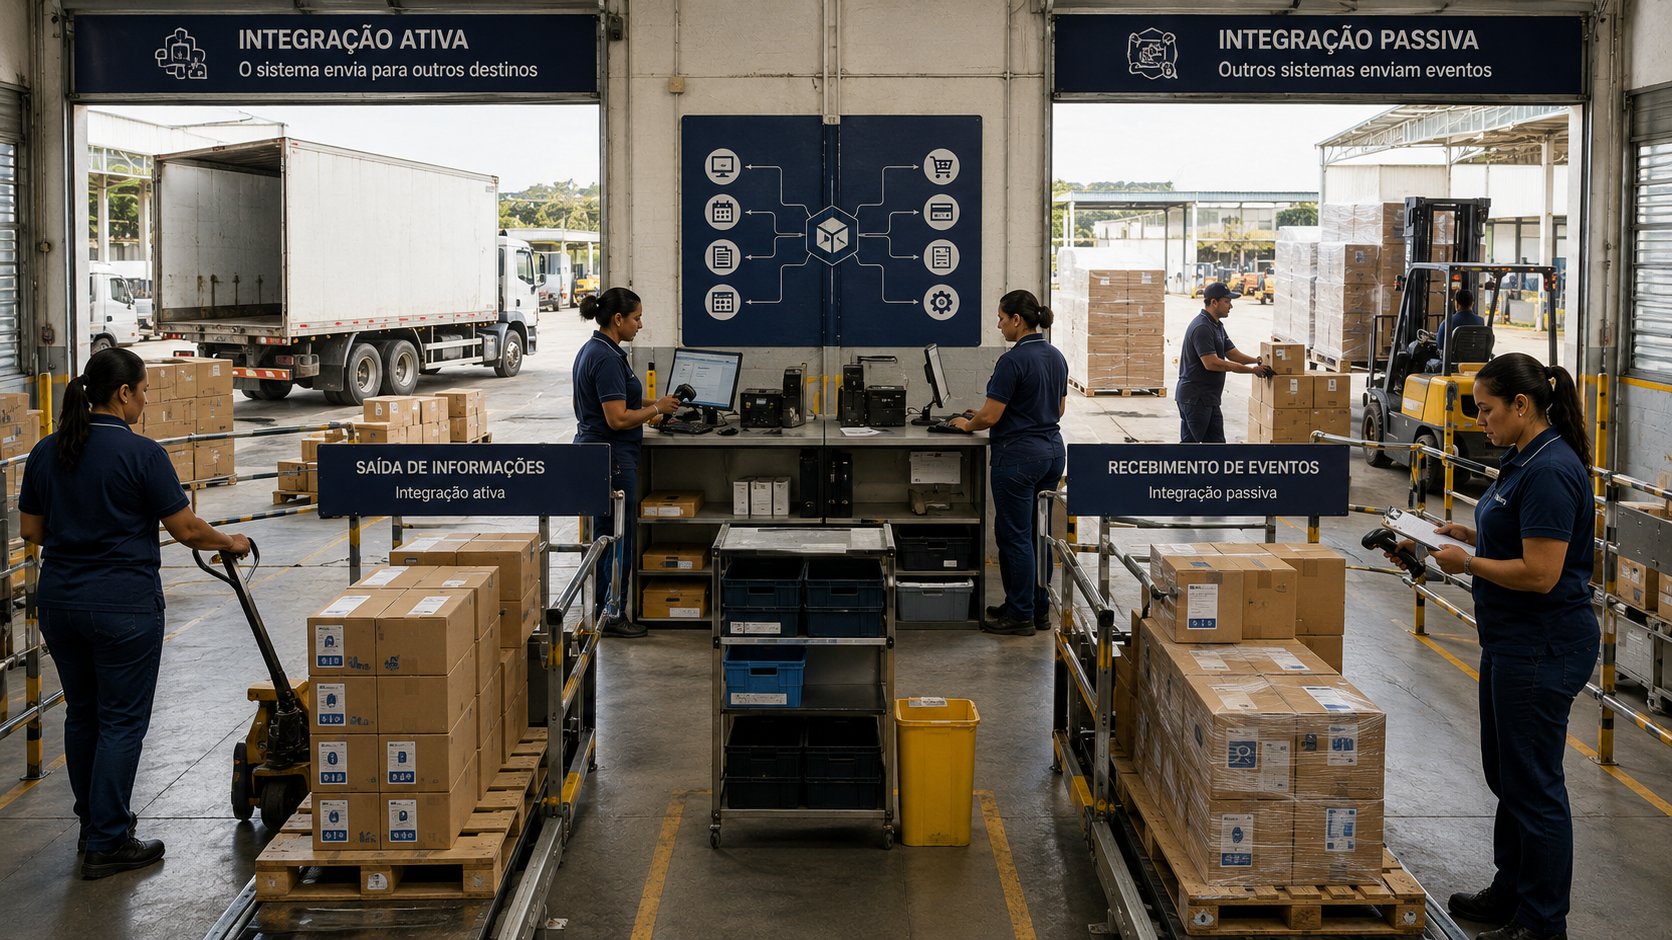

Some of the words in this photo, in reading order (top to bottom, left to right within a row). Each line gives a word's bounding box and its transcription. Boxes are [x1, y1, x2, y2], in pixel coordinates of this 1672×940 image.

[238, 24, 393, 55] INTEGRAÇÃO
[399, 29, 469, 50] ATIVA
[1219, 25, 1373, 55] INTEGRAÇÃO
[1380, 29, 1479, 50] PASSIVA
[239, 61, 252, 77] O
[256, 60, 320, 77] sistema
[324, 60, 367, 77] envia
[372, 65, 408, 81] para
[412, 62, 465, 77] outros
[469, 60, 538, 78] destinos
[1218, 60, 1276, 78] Outros
[1280, 61, 1355, 78] sistemas
[1359, 61, 1421, 78] enviam
[1425, 62, 1492, 78] eventos
[356, 456, 404, 475] SAÍDA
[407, 460, 428, 475] DE
[432, 457, 545, 478] INFORMAÇÕES
[1108, 460, 1220, 475] RECEBIMENTO
[1223, 460, 1244, 474] DE
[1248, 460, 1320, 475] EVENTOS
[396, 485, 469, 503] Integração
[472, 485, 506, 500] ativa
[1148, 485, 1222, 503] Integração
[1226, 485, 1278, 502] passiva
